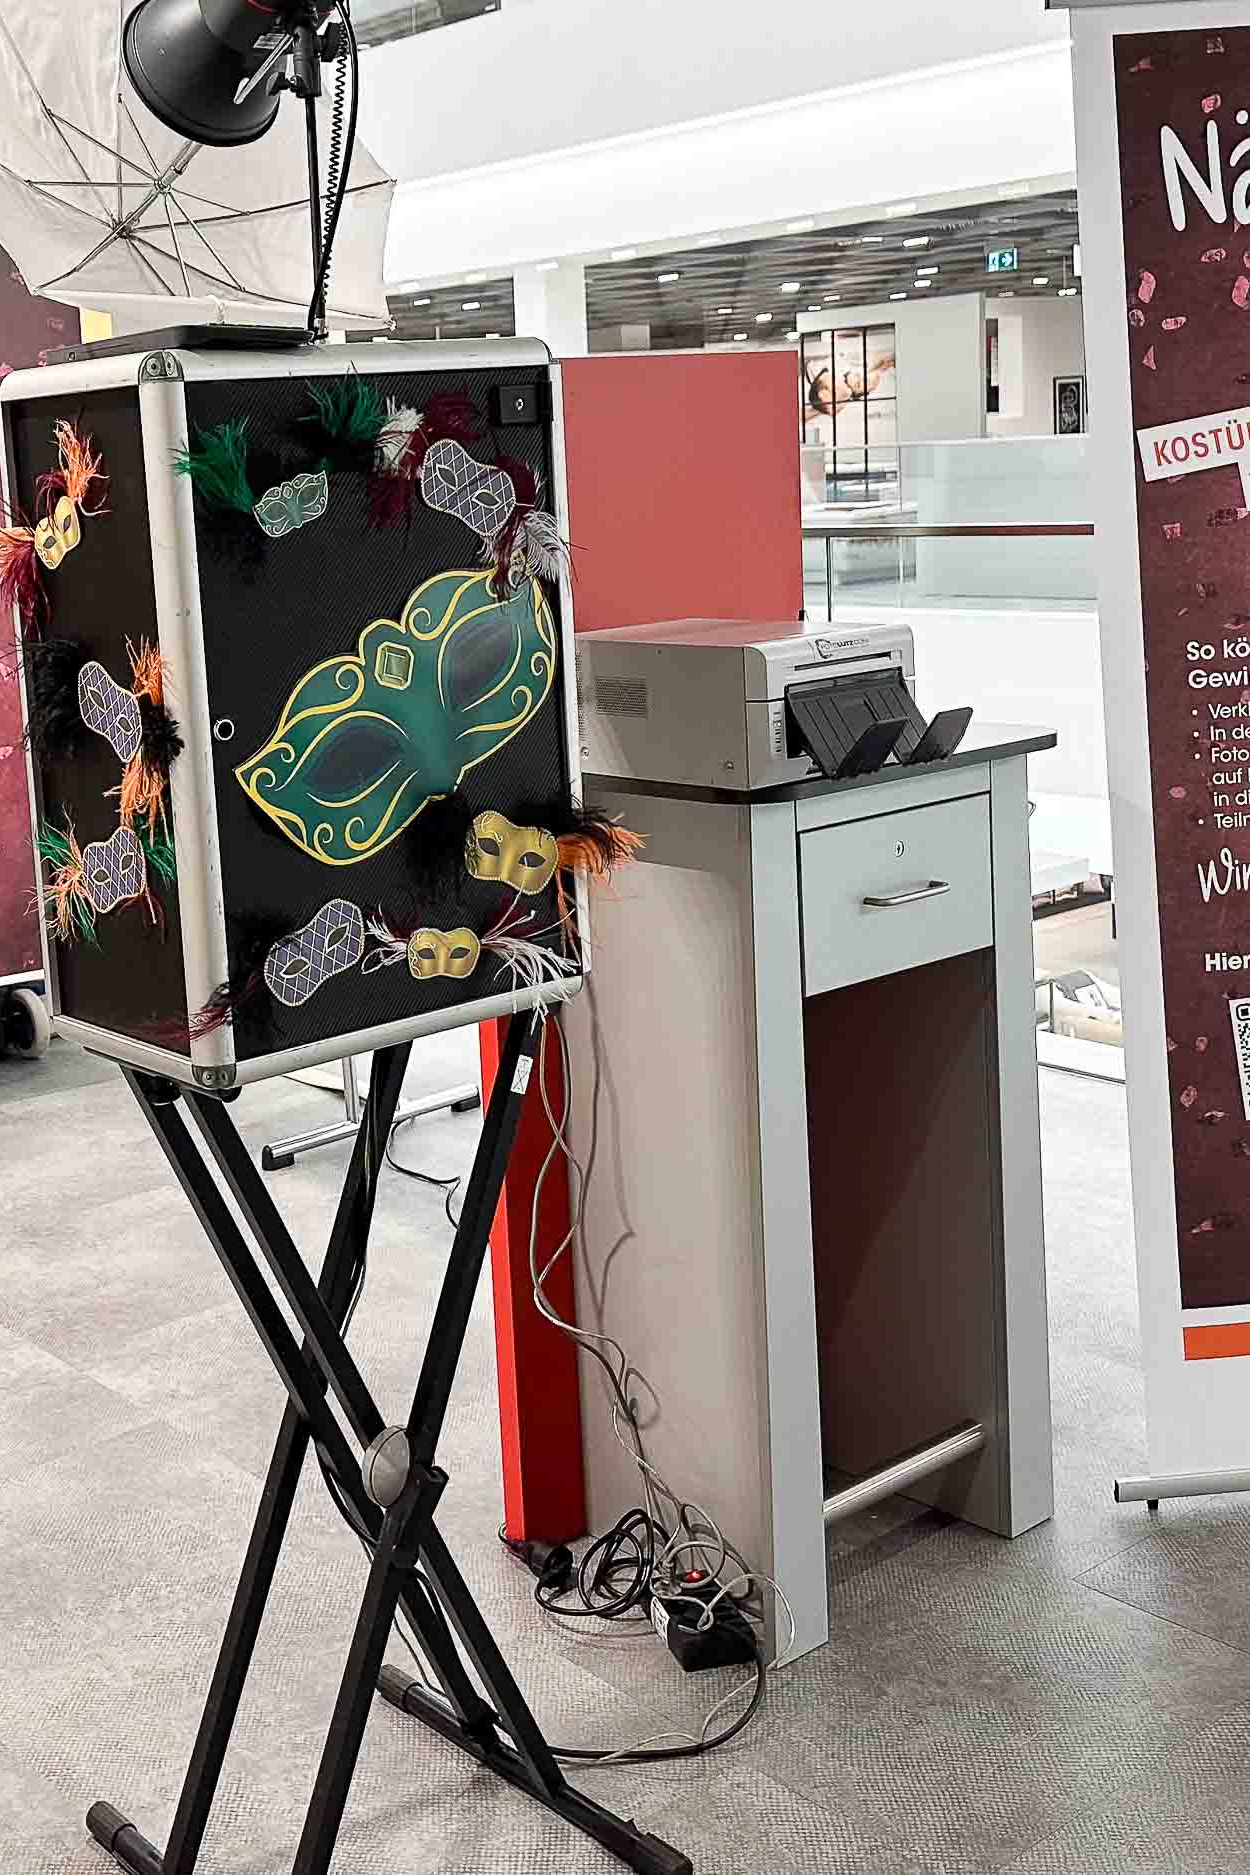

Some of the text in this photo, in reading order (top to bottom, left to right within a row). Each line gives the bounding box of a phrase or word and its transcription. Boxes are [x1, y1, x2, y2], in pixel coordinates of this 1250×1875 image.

[1186, 641, 1216, 661] So
[1210, 725, 1227, 741] In
[1211, 746, 1250, 763] Foto
[1213, 768, 1243, 785] auf
[1213, 791, 1230, 807] in
